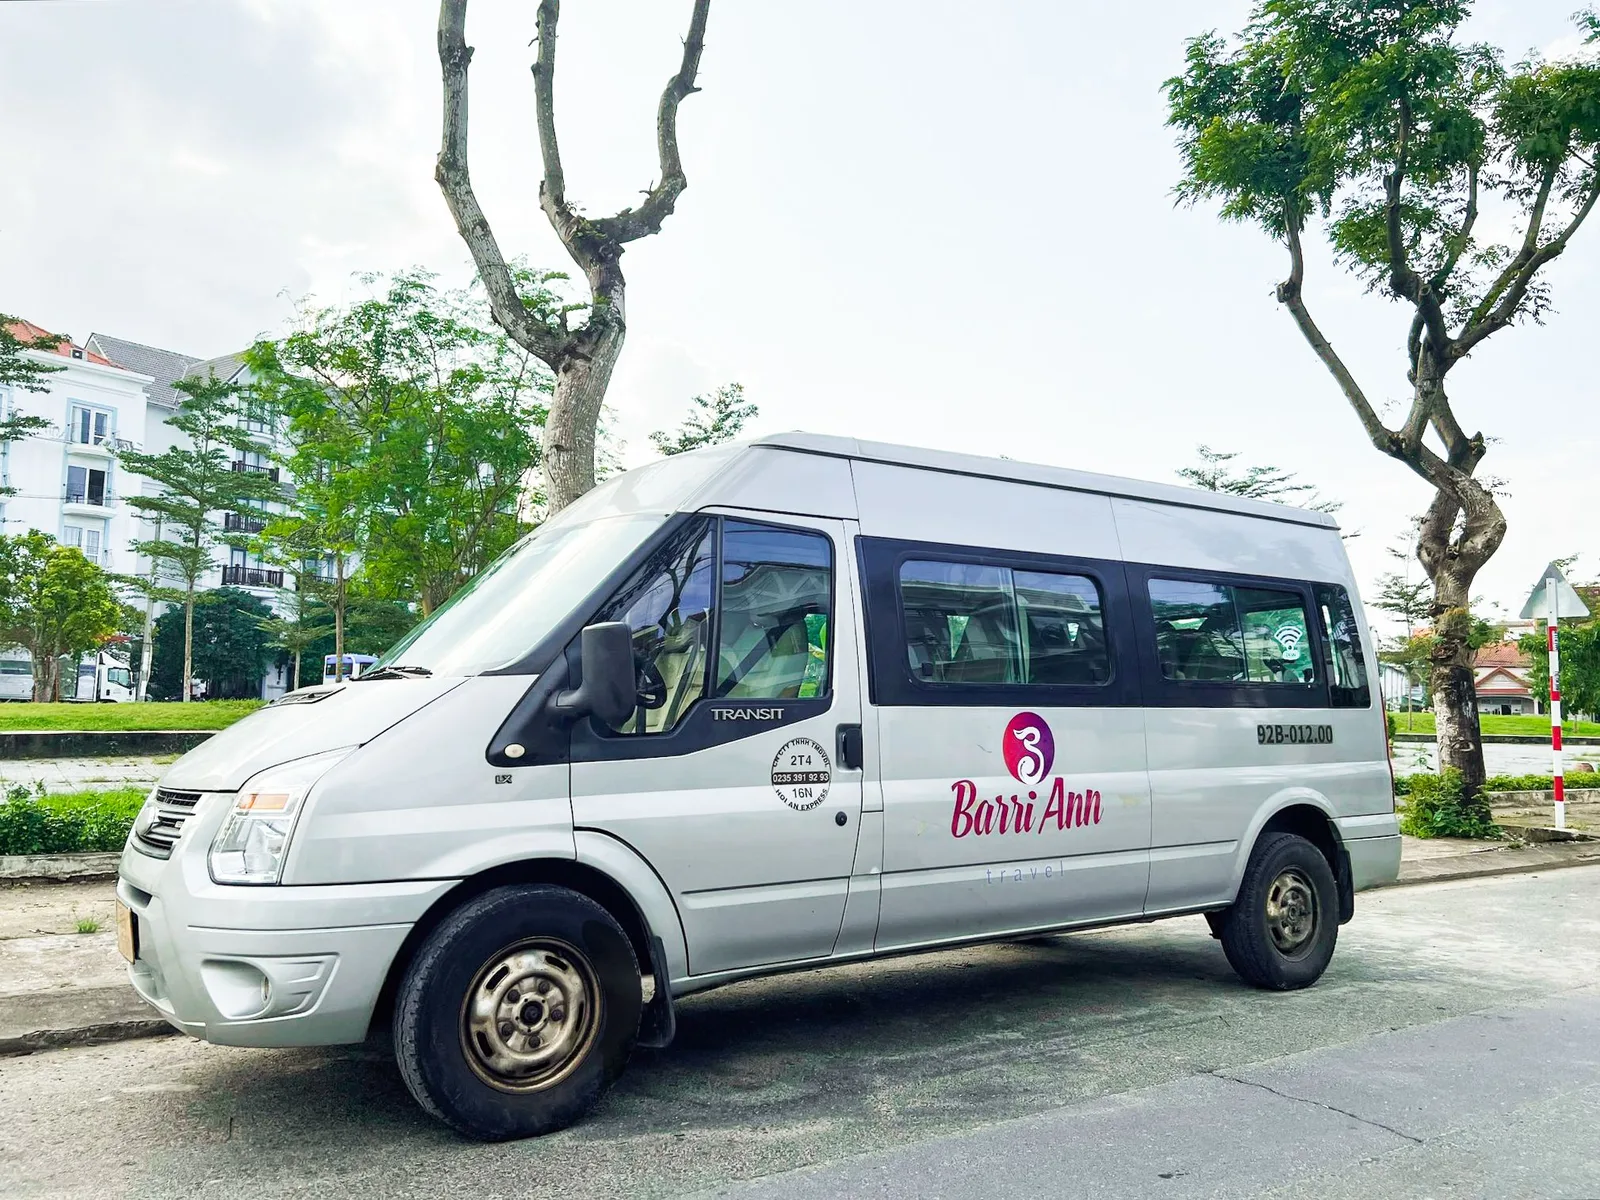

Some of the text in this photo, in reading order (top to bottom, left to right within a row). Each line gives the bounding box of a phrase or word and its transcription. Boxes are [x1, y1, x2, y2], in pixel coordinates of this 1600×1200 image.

[711, 708, 785, 720] TRANSIT
[1257, 725, 1333, 744] 92B-012.00
[778, 742, 790, 756] CTY
[790, 738, 810, 746] TNHH
[790, 754, 812, 766] 2T4
[772, 773, 829, 783] 0235 391 92 93
[775, 788, 828, 811] HOI AN EXPRESS
[792, 787, 813, 799] 16N
[951, 777, 1104, 838] Barri Ann
[986, 860, 1065, 884] travel
